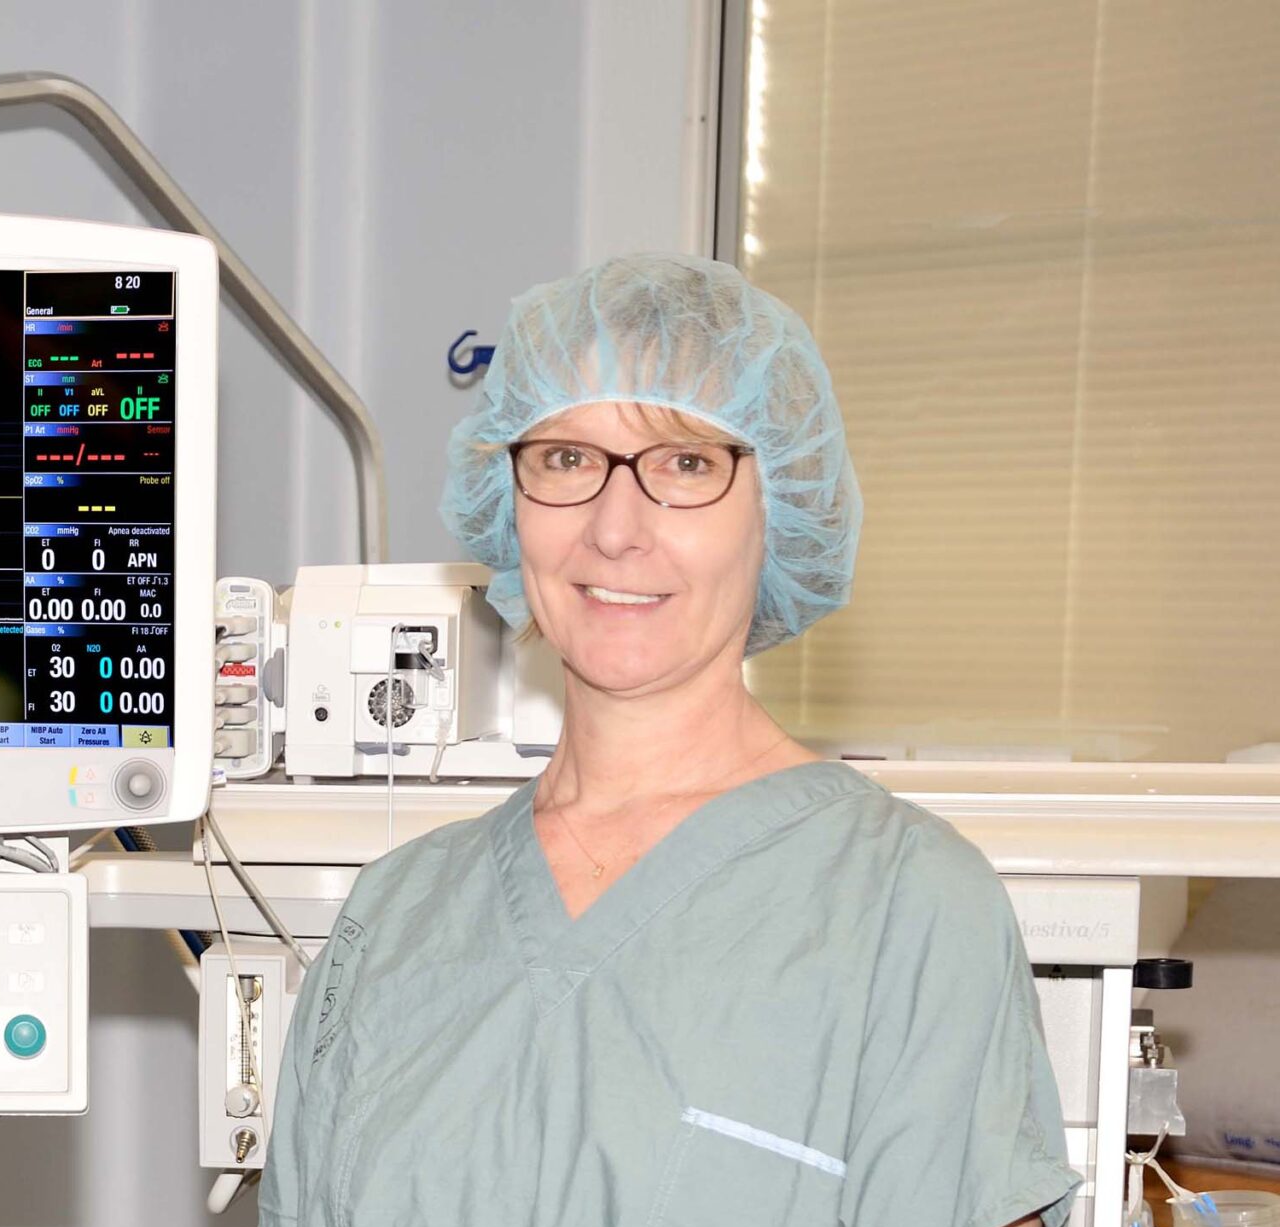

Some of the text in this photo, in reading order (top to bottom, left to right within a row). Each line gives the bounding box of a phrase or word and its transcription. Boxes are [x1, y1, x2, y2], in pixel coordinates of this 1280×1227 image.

[115, 275, 141, 289] 8 20
[26, 307, 53, 315] General
[25, 324, 36, 332] HR
[28, 359, 43, 368] ECG
[91, 360, 103, 368] Art
[25, 375, 35, 383] ST
[64, 388, 74, 396] V1
[91, 388, 105, 396] aVL
[30, 405, 51, 417] OFF
[59, 405, 80, 417] OFF
[87, 405, 109, 417] OFF
[120, 397, 161, 420] OFF
[25, 425, 79, 436] P1 Art mmHg
[147, 425, 171, 434] Sensor
[25, 476, 64, 486] SpO2 %
[139, 476, 171, 485] Probe off
[25, 527, 79, 536] CO2 mmHg
[108, 526, 171, 536] Apnea deactivated
[41, 538, 51, 547] ET
[129, 538, 140, 547] RR
[41, 548, 56, 571] 0
[91, 548, 106, 571] 0
[127, 552, 158, 568] APN
[25, 576, 65, 585] AA %
[127, 577, 137, 585] ET
[137, 577, 151, 585] OFF
[41, 588, 51, 596] ET
[140, 589, 157, 598] MAC
[29, 598, 74, 621] 0.00
[81, 598, 126, 621] 0.00
[140, 603, 162, 618] 0.0
[26, 626, 65, 635] Gases %
[155, 627, 169, 636] OFF
[136, 644, 147, 653] AA
[49, 656, 75, 679] 30
[99, 656, 113, 679] 0
[120, 657, 166, 680] 0.00
[27, 669, 36, 677] ET
[50, 690, 76, 713] 30
[99, 691, 113, 714] 0
[119, 691, 165, 714] 0.00
[31, 726, 63, 735] NIBP Auto
[81, 727, 107, 735] Zero All
[39, 737, 56, 745] Start
[78, 738, 110, 746] Pressures
